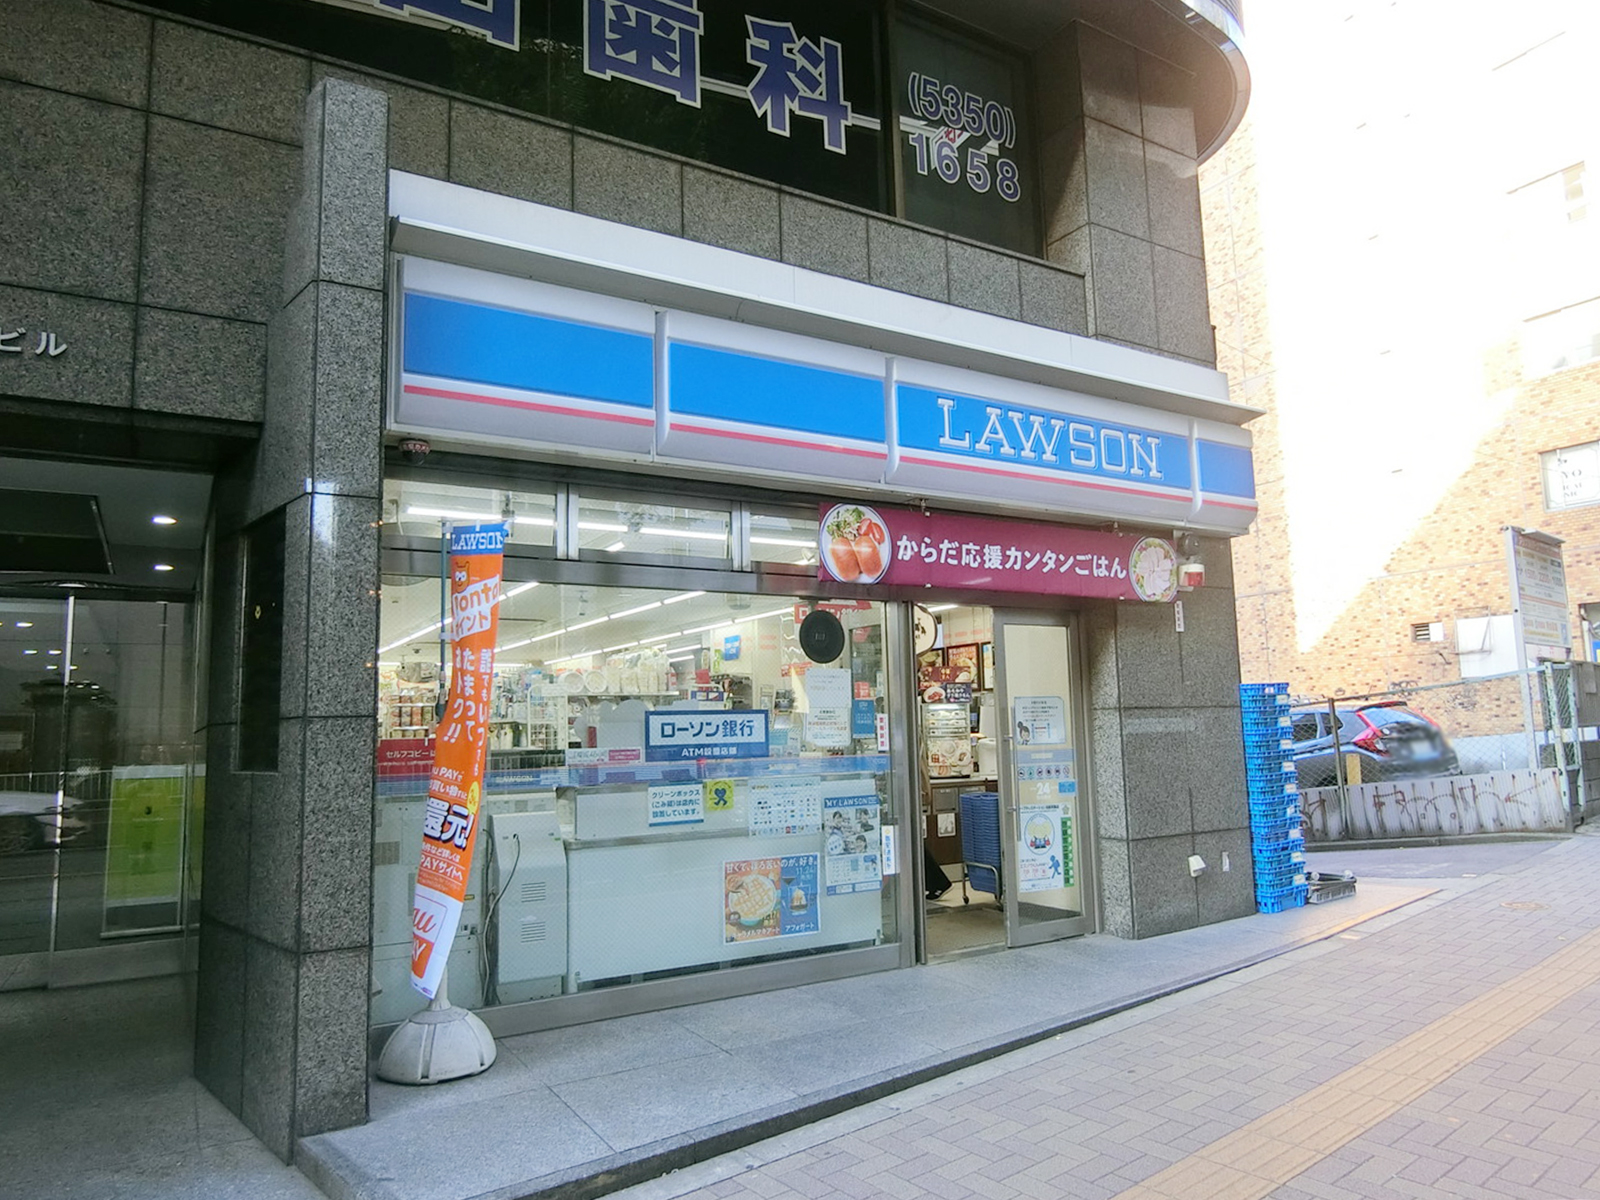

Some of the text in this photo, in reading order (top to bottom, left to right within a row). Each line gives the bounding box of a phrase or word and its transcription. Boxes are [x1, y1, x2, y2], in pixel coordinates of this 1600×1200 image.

[908, 71, 1016, 149] (5350)
[908, 132, 1021, 202] 1658
[937, 398, 1164, 480] LAWSON
[897, 535, 1128, 581] からだ応援カンタンごはん
[462, 647, 476, 742] たまって
[661, 719, 755, 739] ローソン銀行
[652, 789, 700, 799] クリーンボックス
